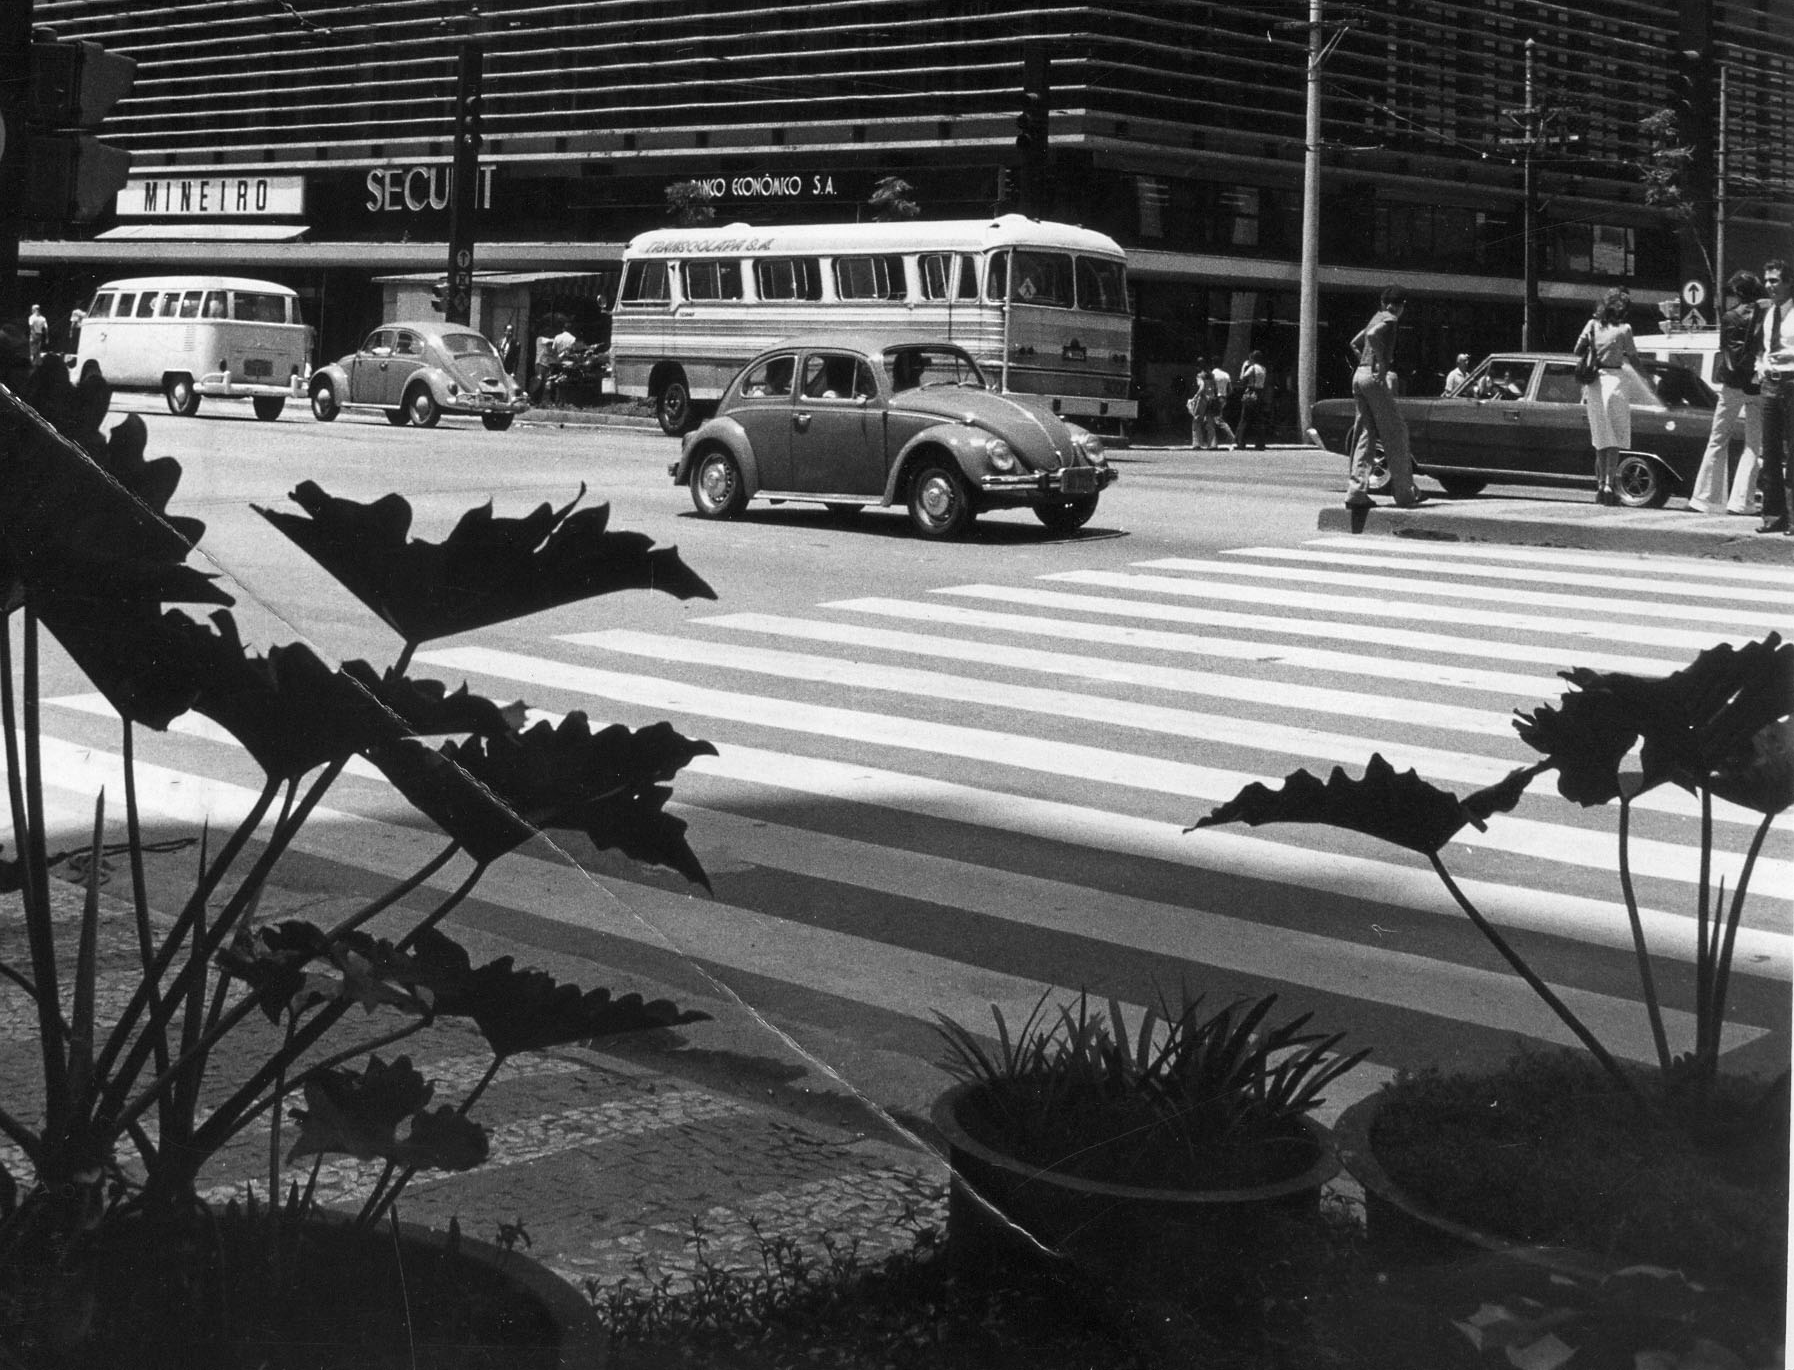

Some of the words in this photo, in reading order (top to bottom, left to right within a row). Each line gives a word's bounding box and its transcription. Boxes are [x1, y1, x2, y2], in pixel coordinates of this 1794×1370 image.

[144, 179, 268, 212] MINEIRO
[366, 165, 497, 211] SECUT
[732, 173, 802, 196] ECONÔMICO
[814, 175, 837, 195] S.A.
